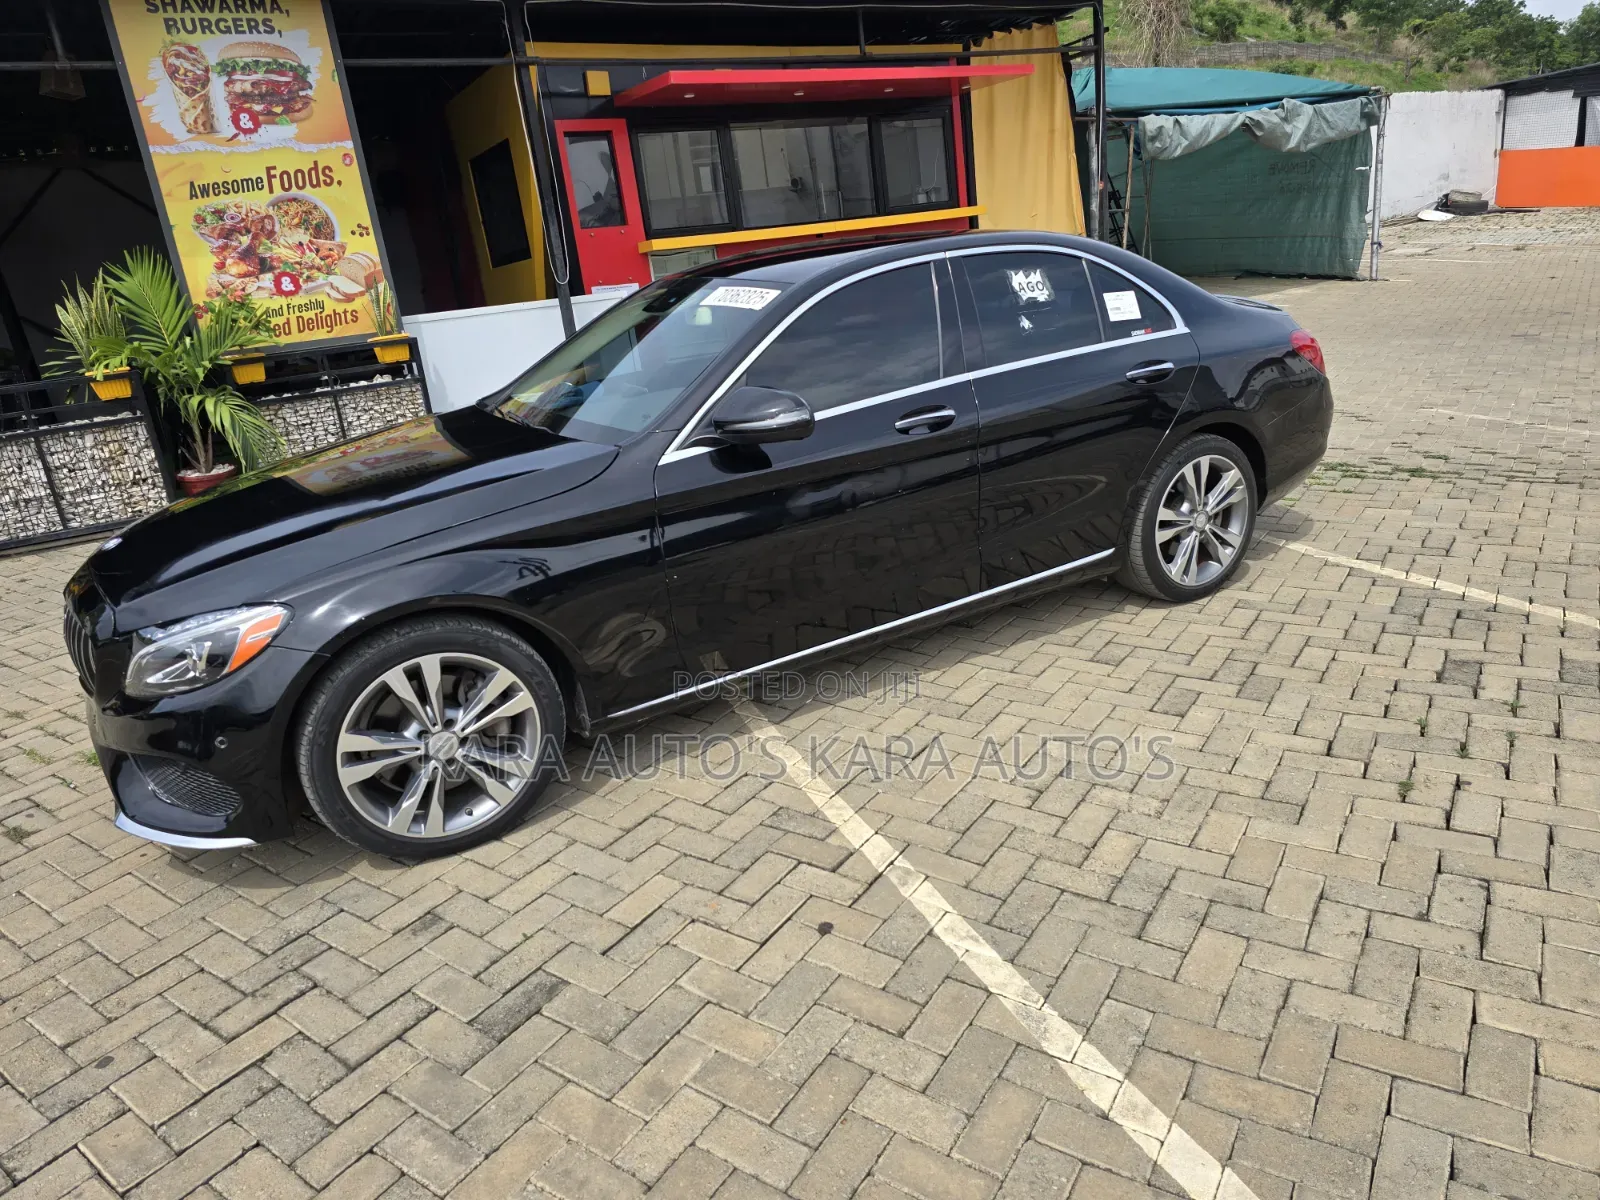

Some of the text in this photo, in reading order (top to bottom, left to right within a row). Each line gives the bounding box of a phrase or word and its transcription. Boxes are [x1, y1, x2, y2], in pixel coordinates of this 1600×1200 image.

[145, 0, 290, 17] SHAWARMA,
[163, 17, 283, 38] BURGERS,
[240, 113, 254, 129] &
[189, 160, 343, 200] Awesome Foods,
[280, 276, 295, 291] &
[1018, 281, 1045, 294] AGO
[286, 298, 325, 316] Freshly
[296, 308, 359, 333] Delights
